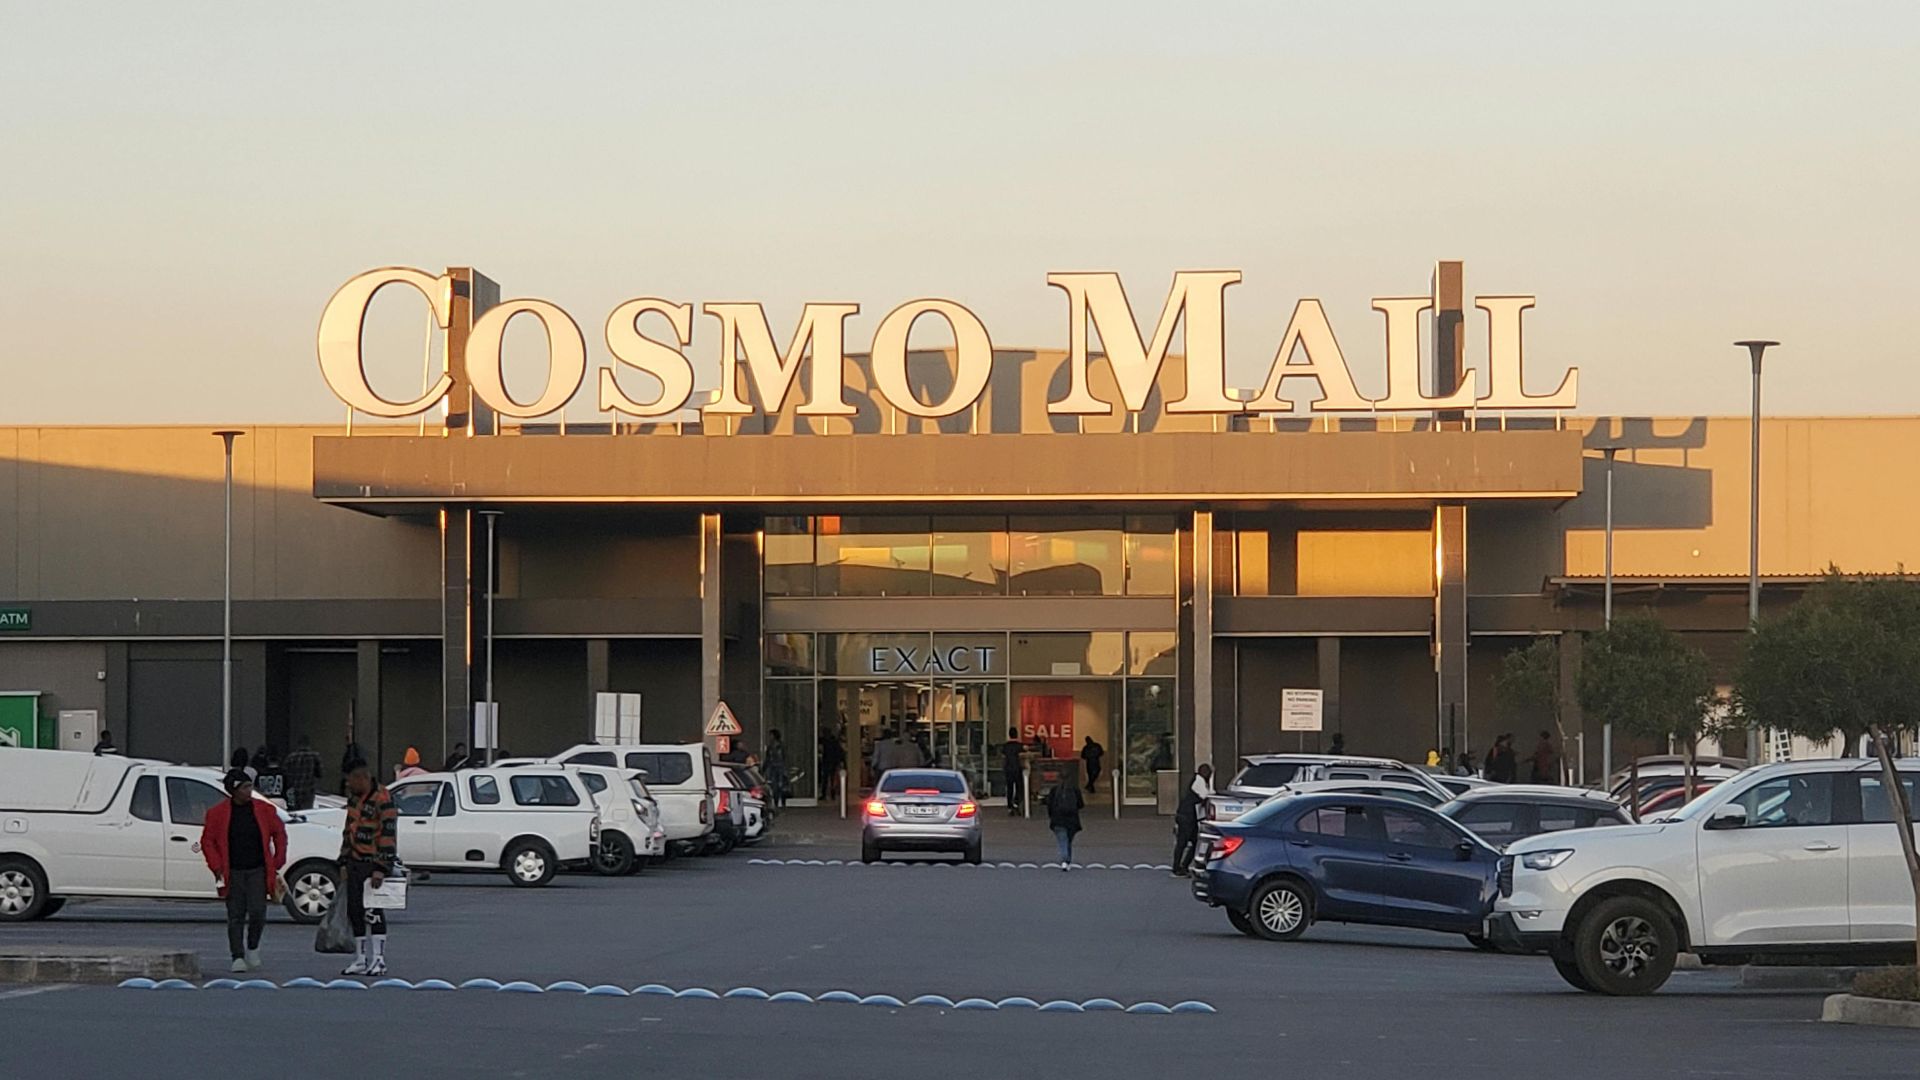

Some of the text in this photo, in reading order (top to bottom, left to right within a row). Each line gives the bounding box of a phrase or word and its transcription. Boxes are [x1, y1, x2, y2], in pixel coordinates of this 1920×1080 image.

[318, 266, 1579, 418] COSMO MALL
[0, 613, 28, 625] ATM
[871, 646, 997, 673] EXACT
[1023, 724, 1071, 738] SALE
